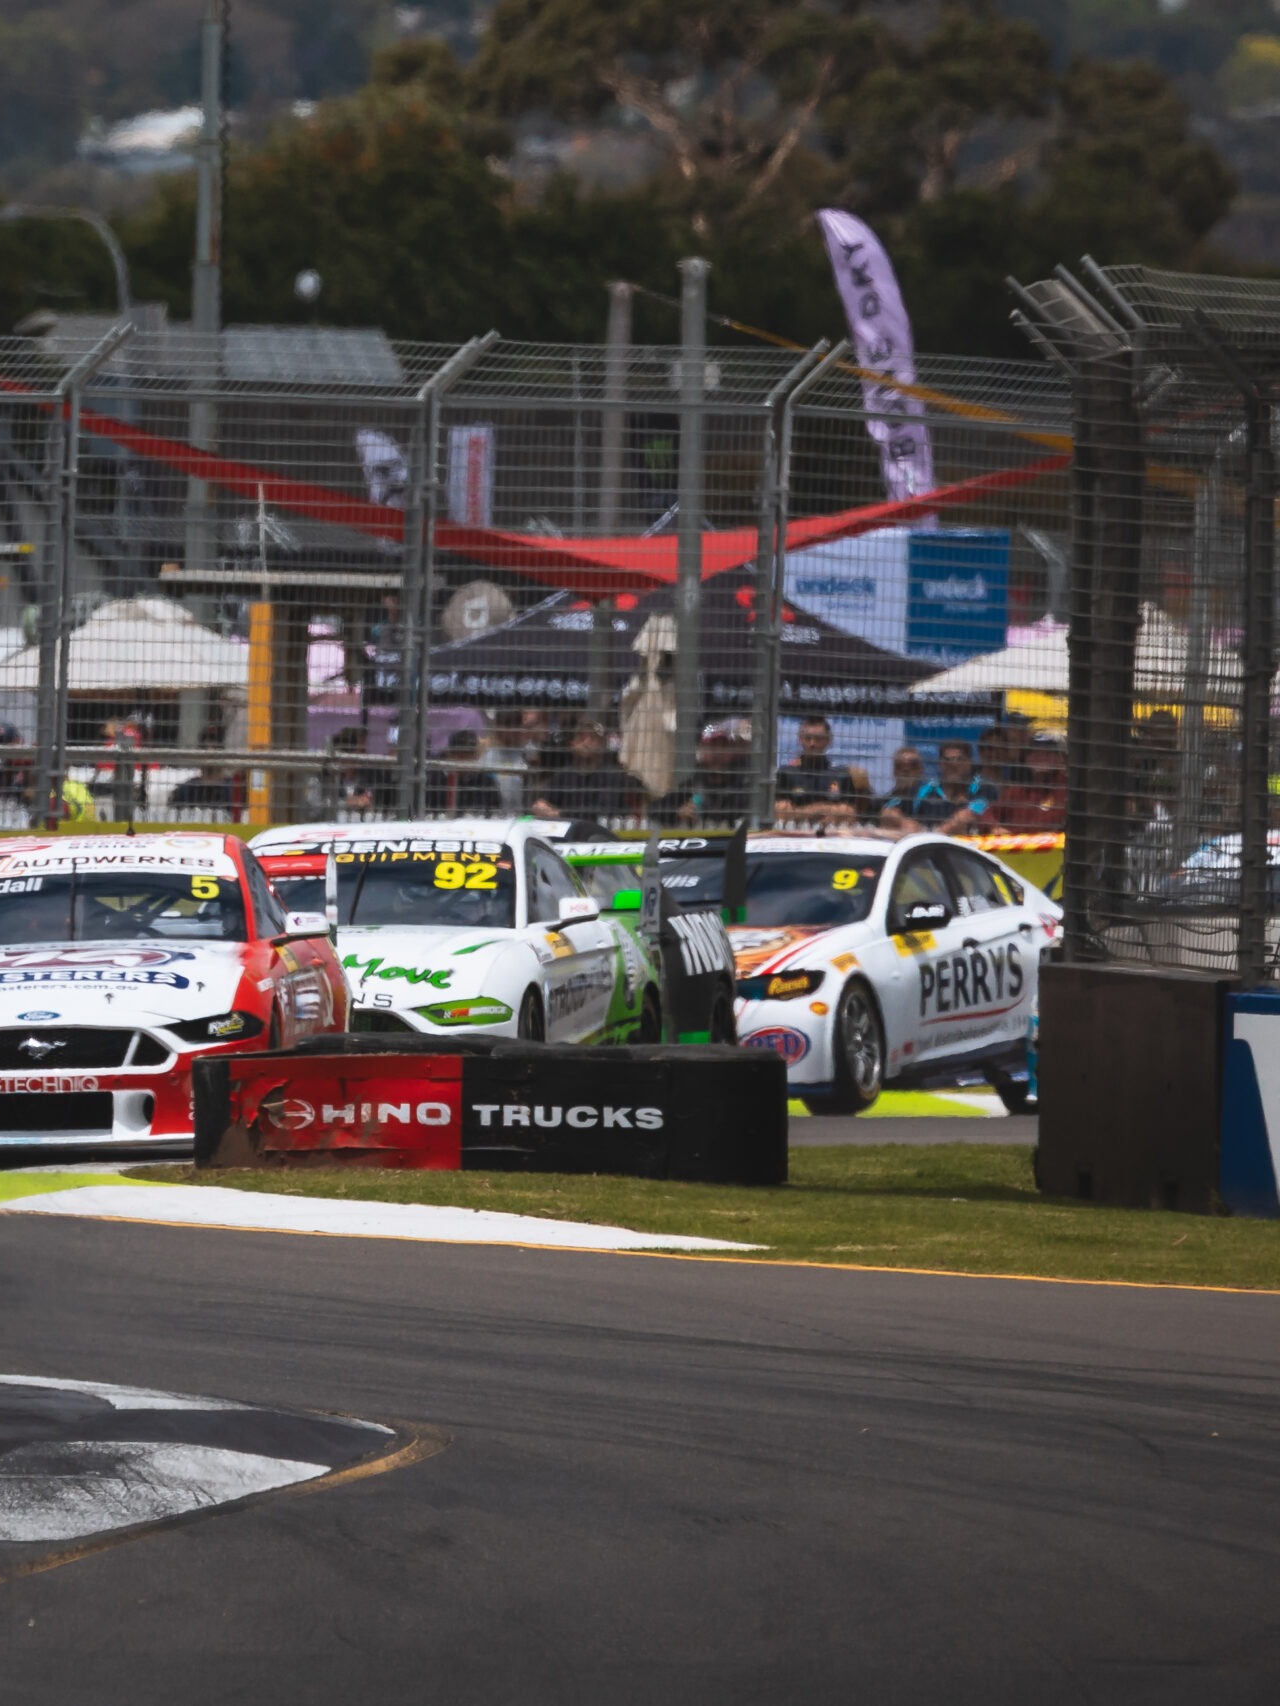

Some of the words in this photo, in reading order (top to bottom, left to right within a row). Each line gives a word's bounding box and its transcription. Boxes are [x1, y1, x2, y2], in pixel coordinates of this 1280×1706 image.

[321, 840, 502, 854] GENESIS
[335, 852, 501, 863] QUIPMENT
[11, 855, 215, 869] AUTOWERKES
[191, 875, 220, 899] 5
[433, 862, 498, 889] 92
[832, 869, 859, 890] 9
[341, 953, 452, 989] Move
[919, 943, 1025, 1017] PERRYS
[321, 1102, 452, 1126] HINO
[472, 1104, 664, 1130] TRUCKS
